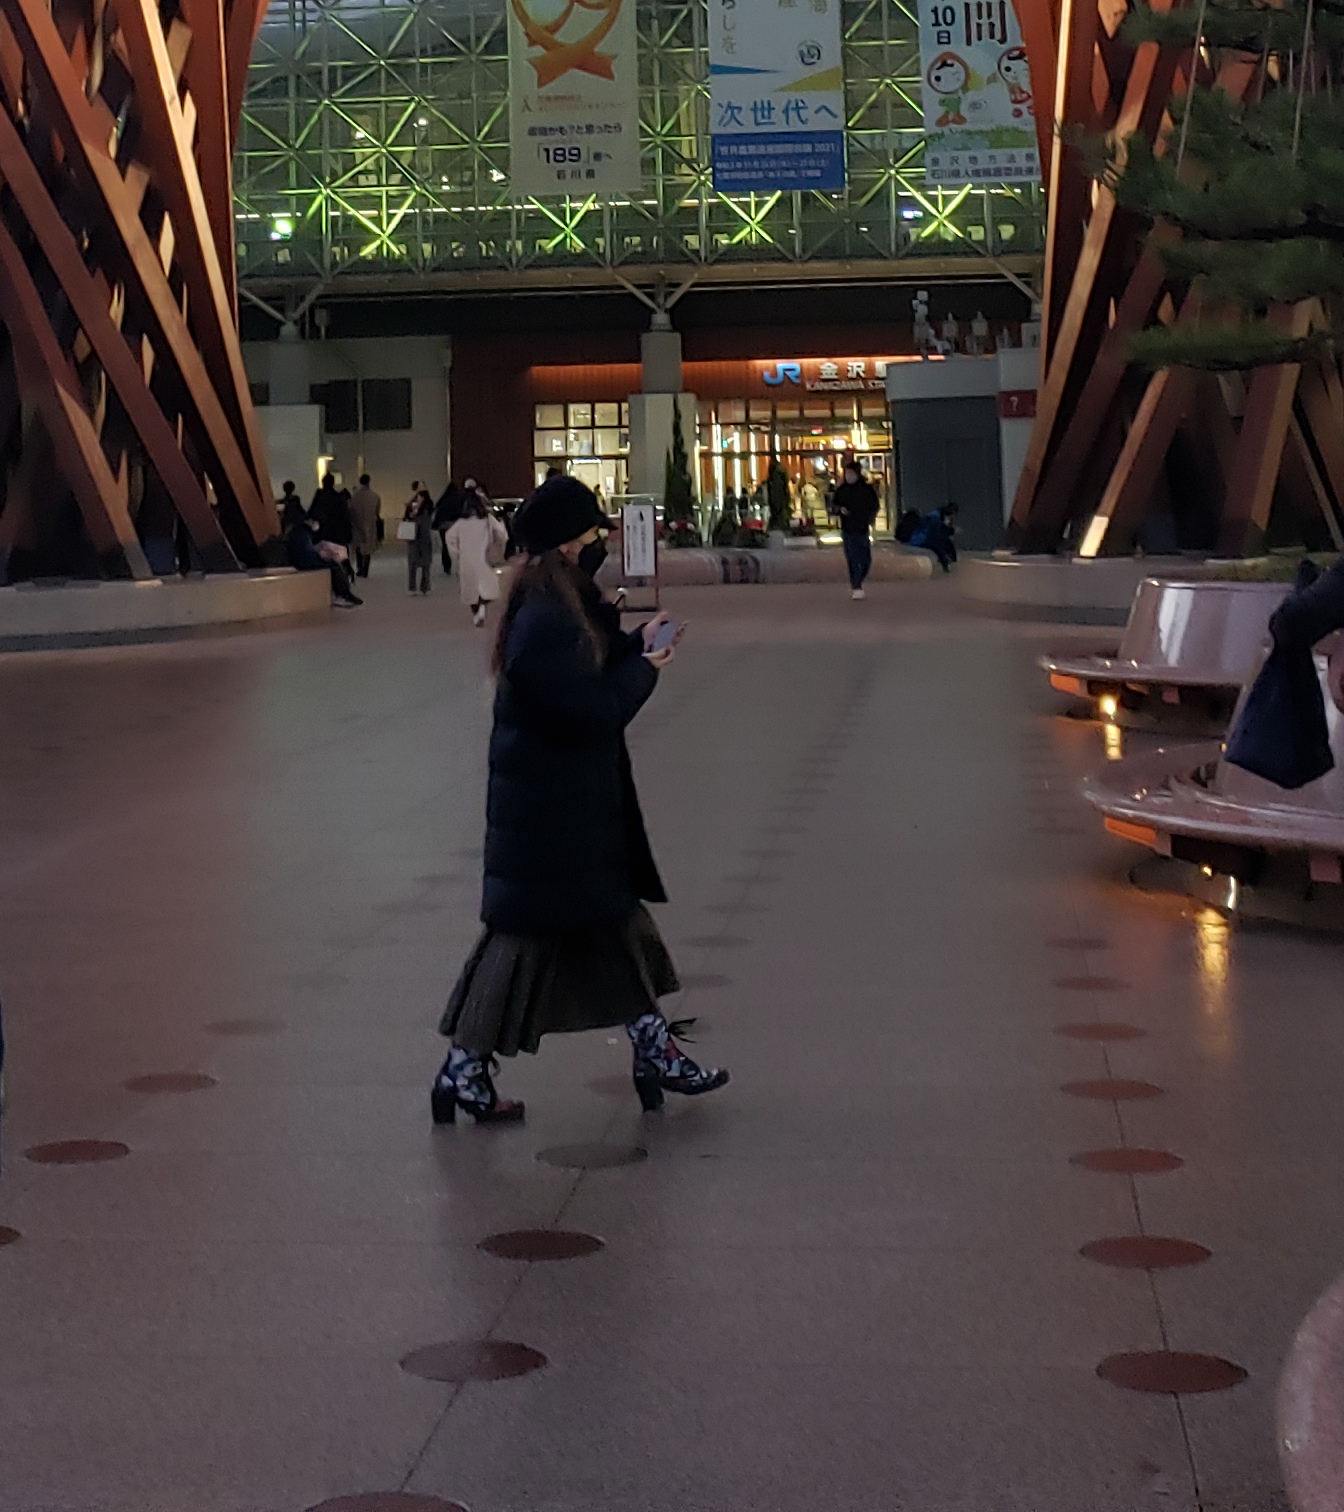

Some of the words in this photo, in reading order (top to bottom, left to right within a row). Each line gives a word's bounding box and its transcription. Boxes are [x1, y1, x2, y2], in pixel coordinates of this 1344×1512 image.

[717, 98, 839, 128] 次世代へ
[762, 361, 802, 386] JR
